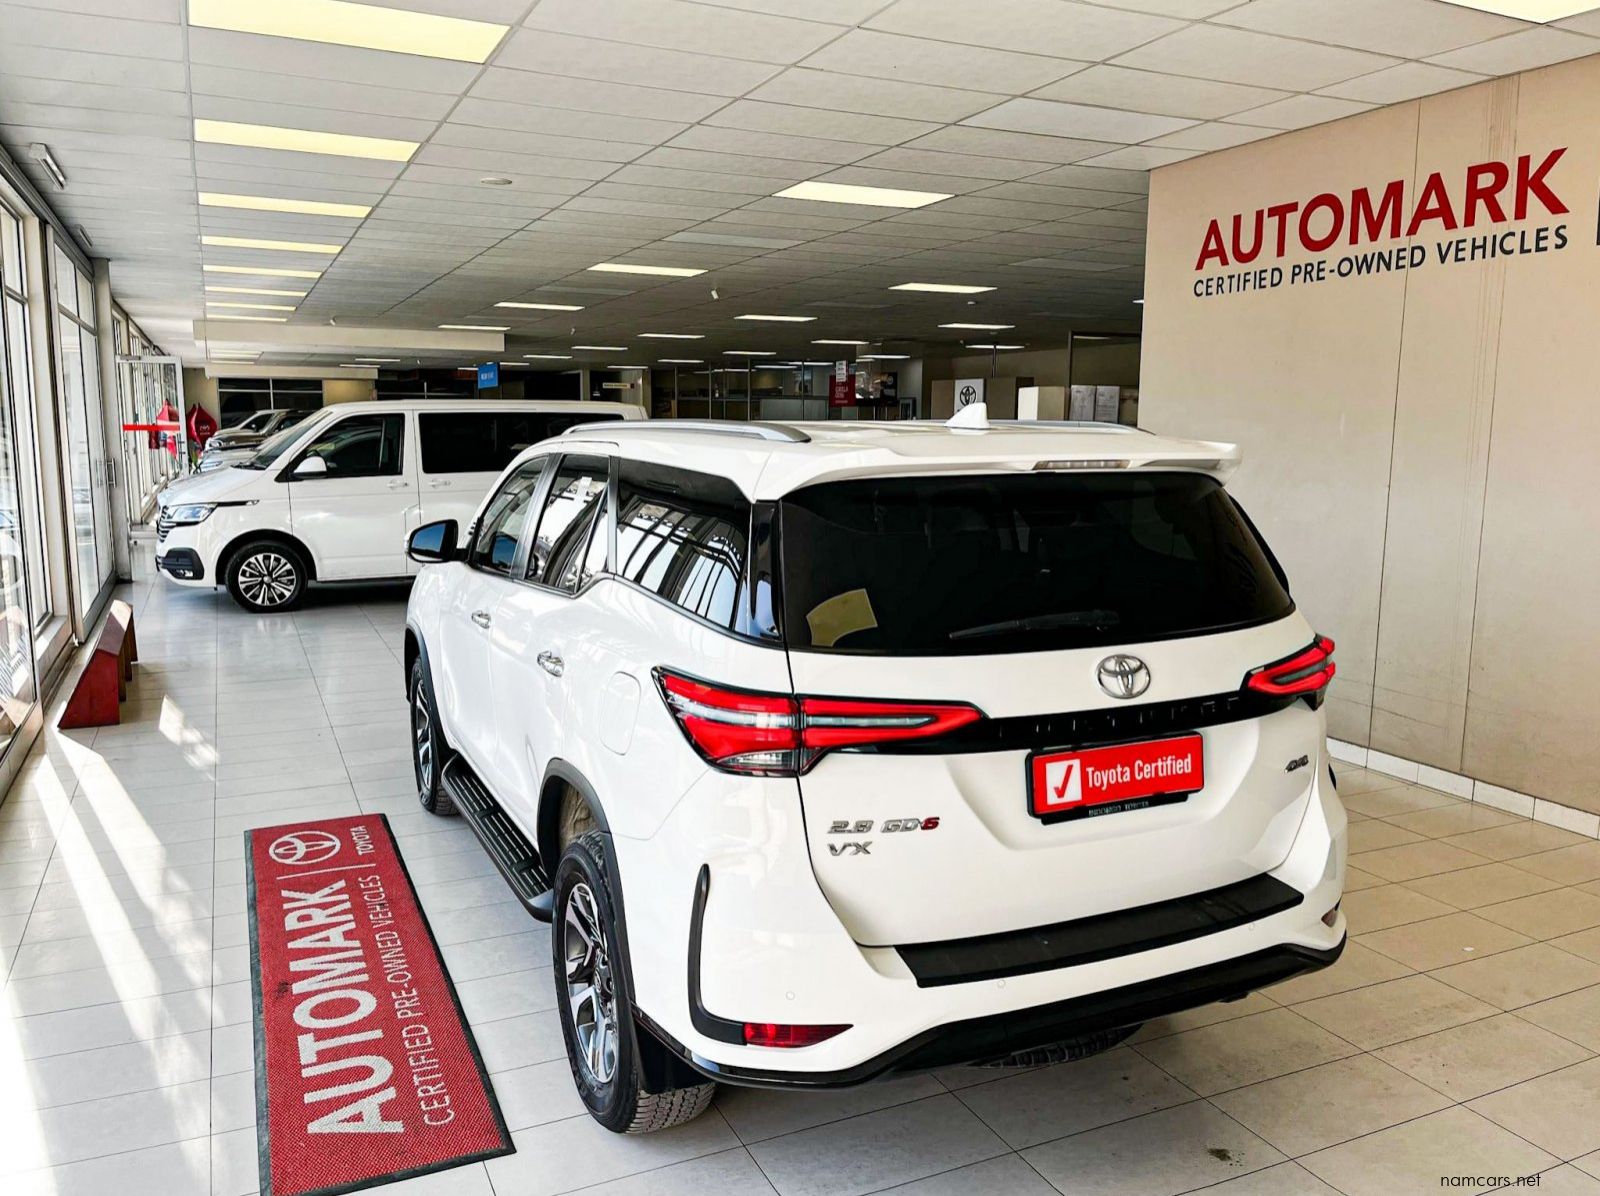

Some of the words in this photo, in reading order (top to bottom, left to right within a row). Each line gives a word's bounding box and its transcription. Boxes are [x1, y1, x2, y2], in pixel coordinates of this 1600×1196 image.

[1195, 147, 1570, 271] AUTOMARK
[1193, 267, 1283, 298] CERTIFIED
[1291, 245, 1426, 285] PRE-OWNED
[1436, 224, 1569, 265] VEHICLES
[1086, 760, 1131, 791] Toyota
[1134, 753, 1192, 781] Certified
[349, 825, 375, 855] TOYOTA
[827, 820, 874, 834] 2.8
[827, 841, 873, 856] VX
[358, 874, 395, 934] VEHICLES
[281, 879, 404, 1134] AUTOMARK
[375, 931, 424, 1020] PRE-OWNED
[402, 1023, 455, 1126] CERTIFIED
